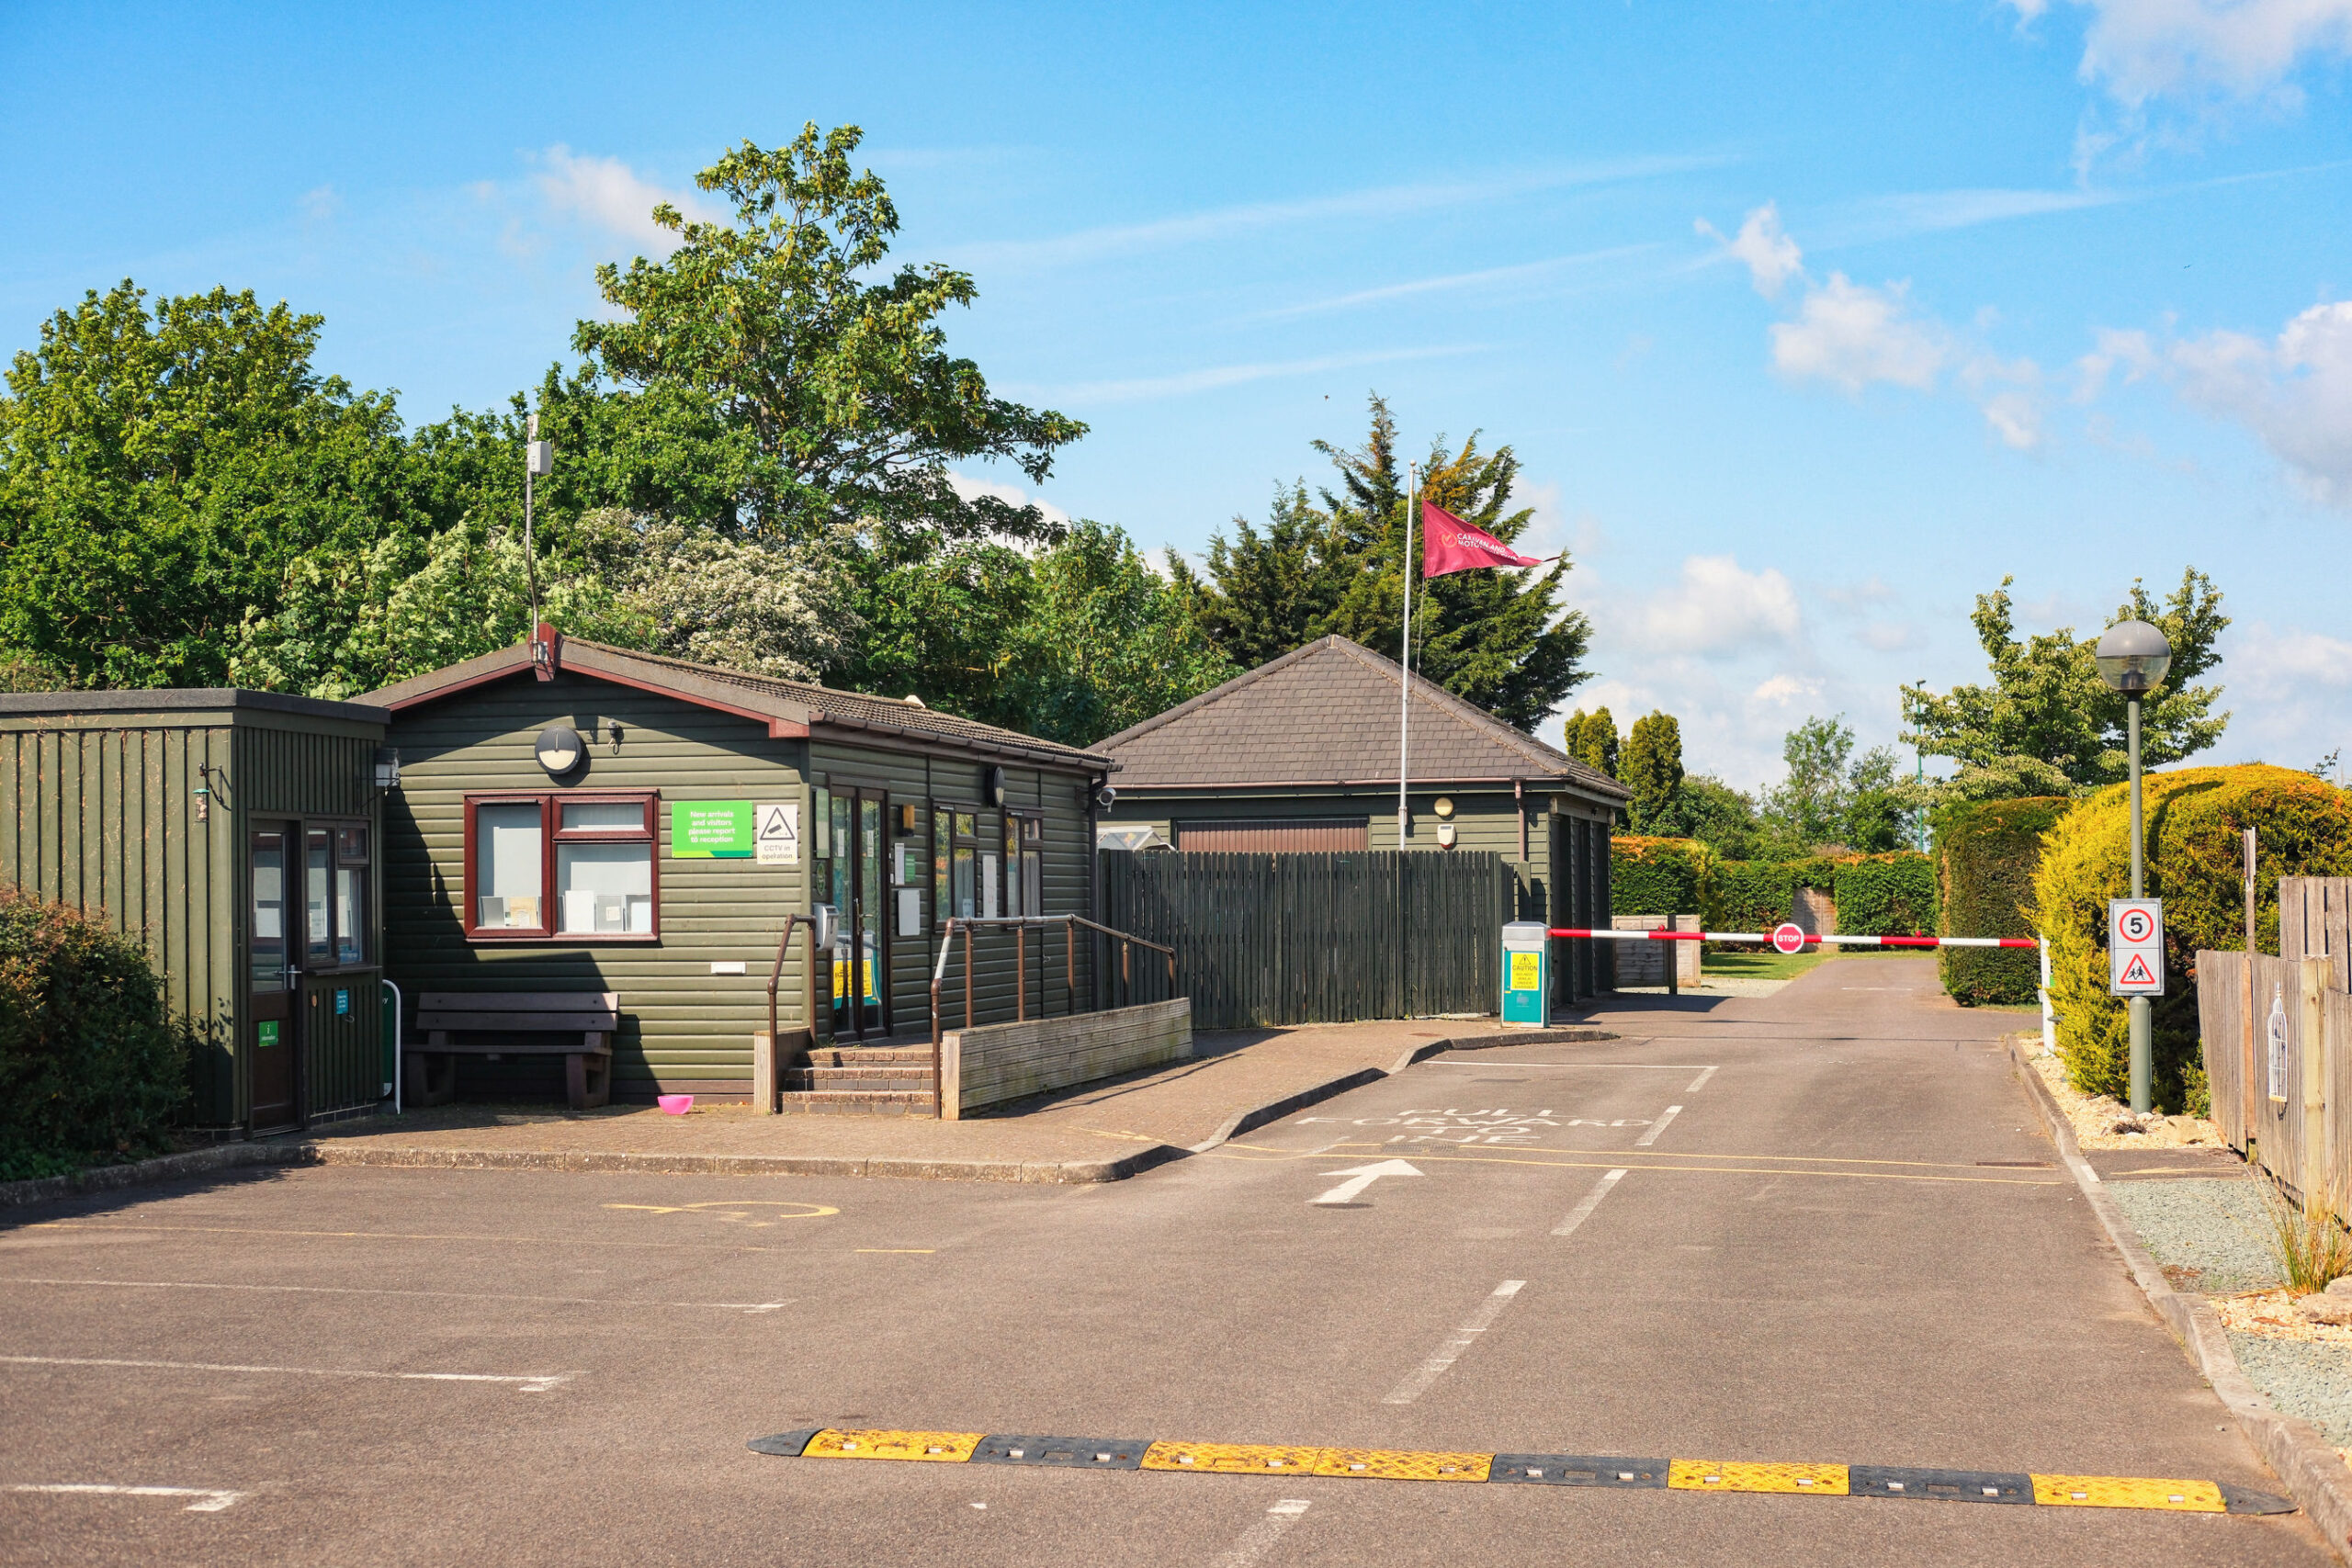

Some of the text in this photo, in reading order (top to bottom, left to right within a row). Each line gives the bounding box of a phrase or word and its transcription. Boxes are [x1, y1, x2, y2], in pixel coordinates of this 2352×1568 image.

[1490, 544, 1506, 553] AND
[700, 836, 733, 844] reception
[2130, 917, 2143, 935] 5
[1397, 1108, 1577, 1117] PULL
[1295, 1117, 1654, 1127] FORWARD
[1406, 1126, 1532, 1134] TO
